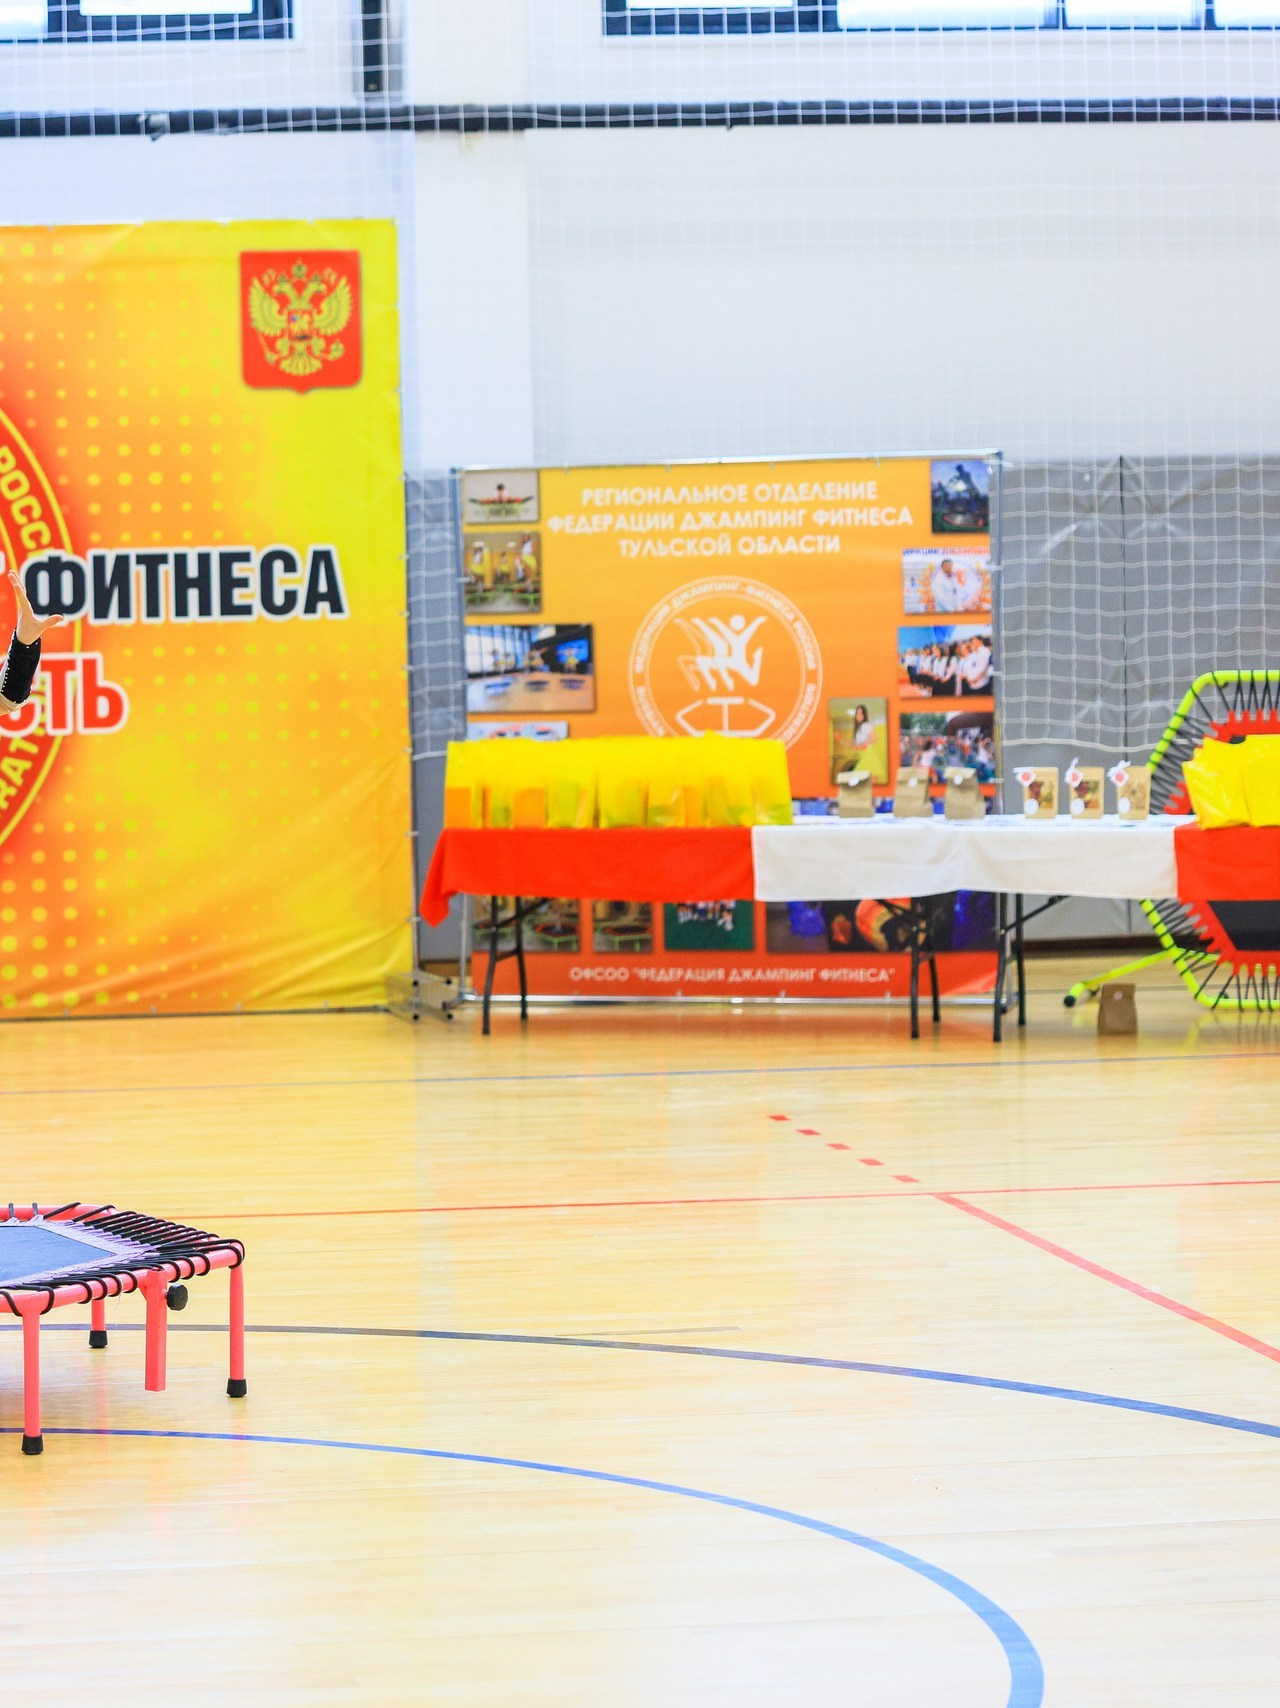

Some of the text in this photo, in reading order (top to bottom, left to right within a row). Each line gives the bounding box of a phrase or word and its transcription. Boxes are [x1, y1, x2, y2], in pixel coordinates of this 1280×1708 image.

[581, 481, 877, 506] РЕГИОНАЛЬНОЕ ОТДЕЛЕНИЕ
[547, 506, 914, 535] ФЕДЕРАЦИИ ДЖАМПИНГ ФИТНЕСА
[618, 533, 840, 558] ТУЛЬСКОЙ ОБЛАСТИ
[23, 547, 346, 624] ФИТНЕСА
[728, 966, 816, 983] ДЖАМПИНГ
